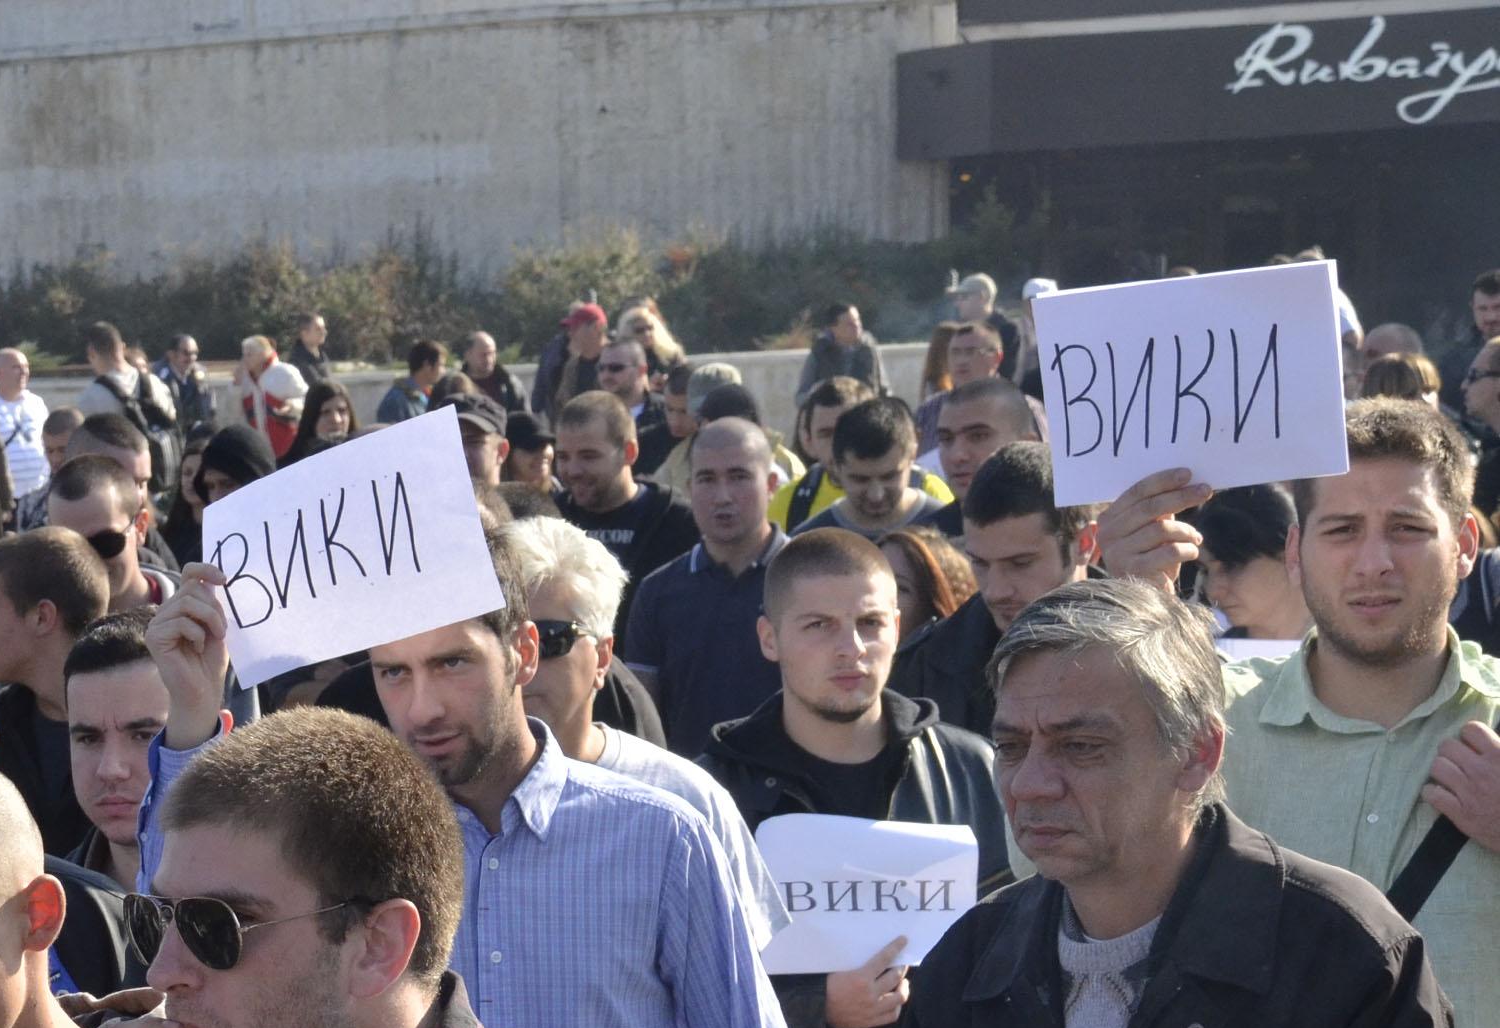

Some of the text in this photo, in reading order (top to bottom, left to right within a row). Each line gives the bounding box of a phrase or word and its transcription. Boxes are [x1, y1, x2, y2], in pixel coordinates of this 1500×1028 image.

[1225, 15, 1500, 124] Rubaiy
[1051, 323, 1281, 457] ВИКИ
[210, 471, 421, 629] ВИКИ
[779, 879, 955, 912] ВИКИ
